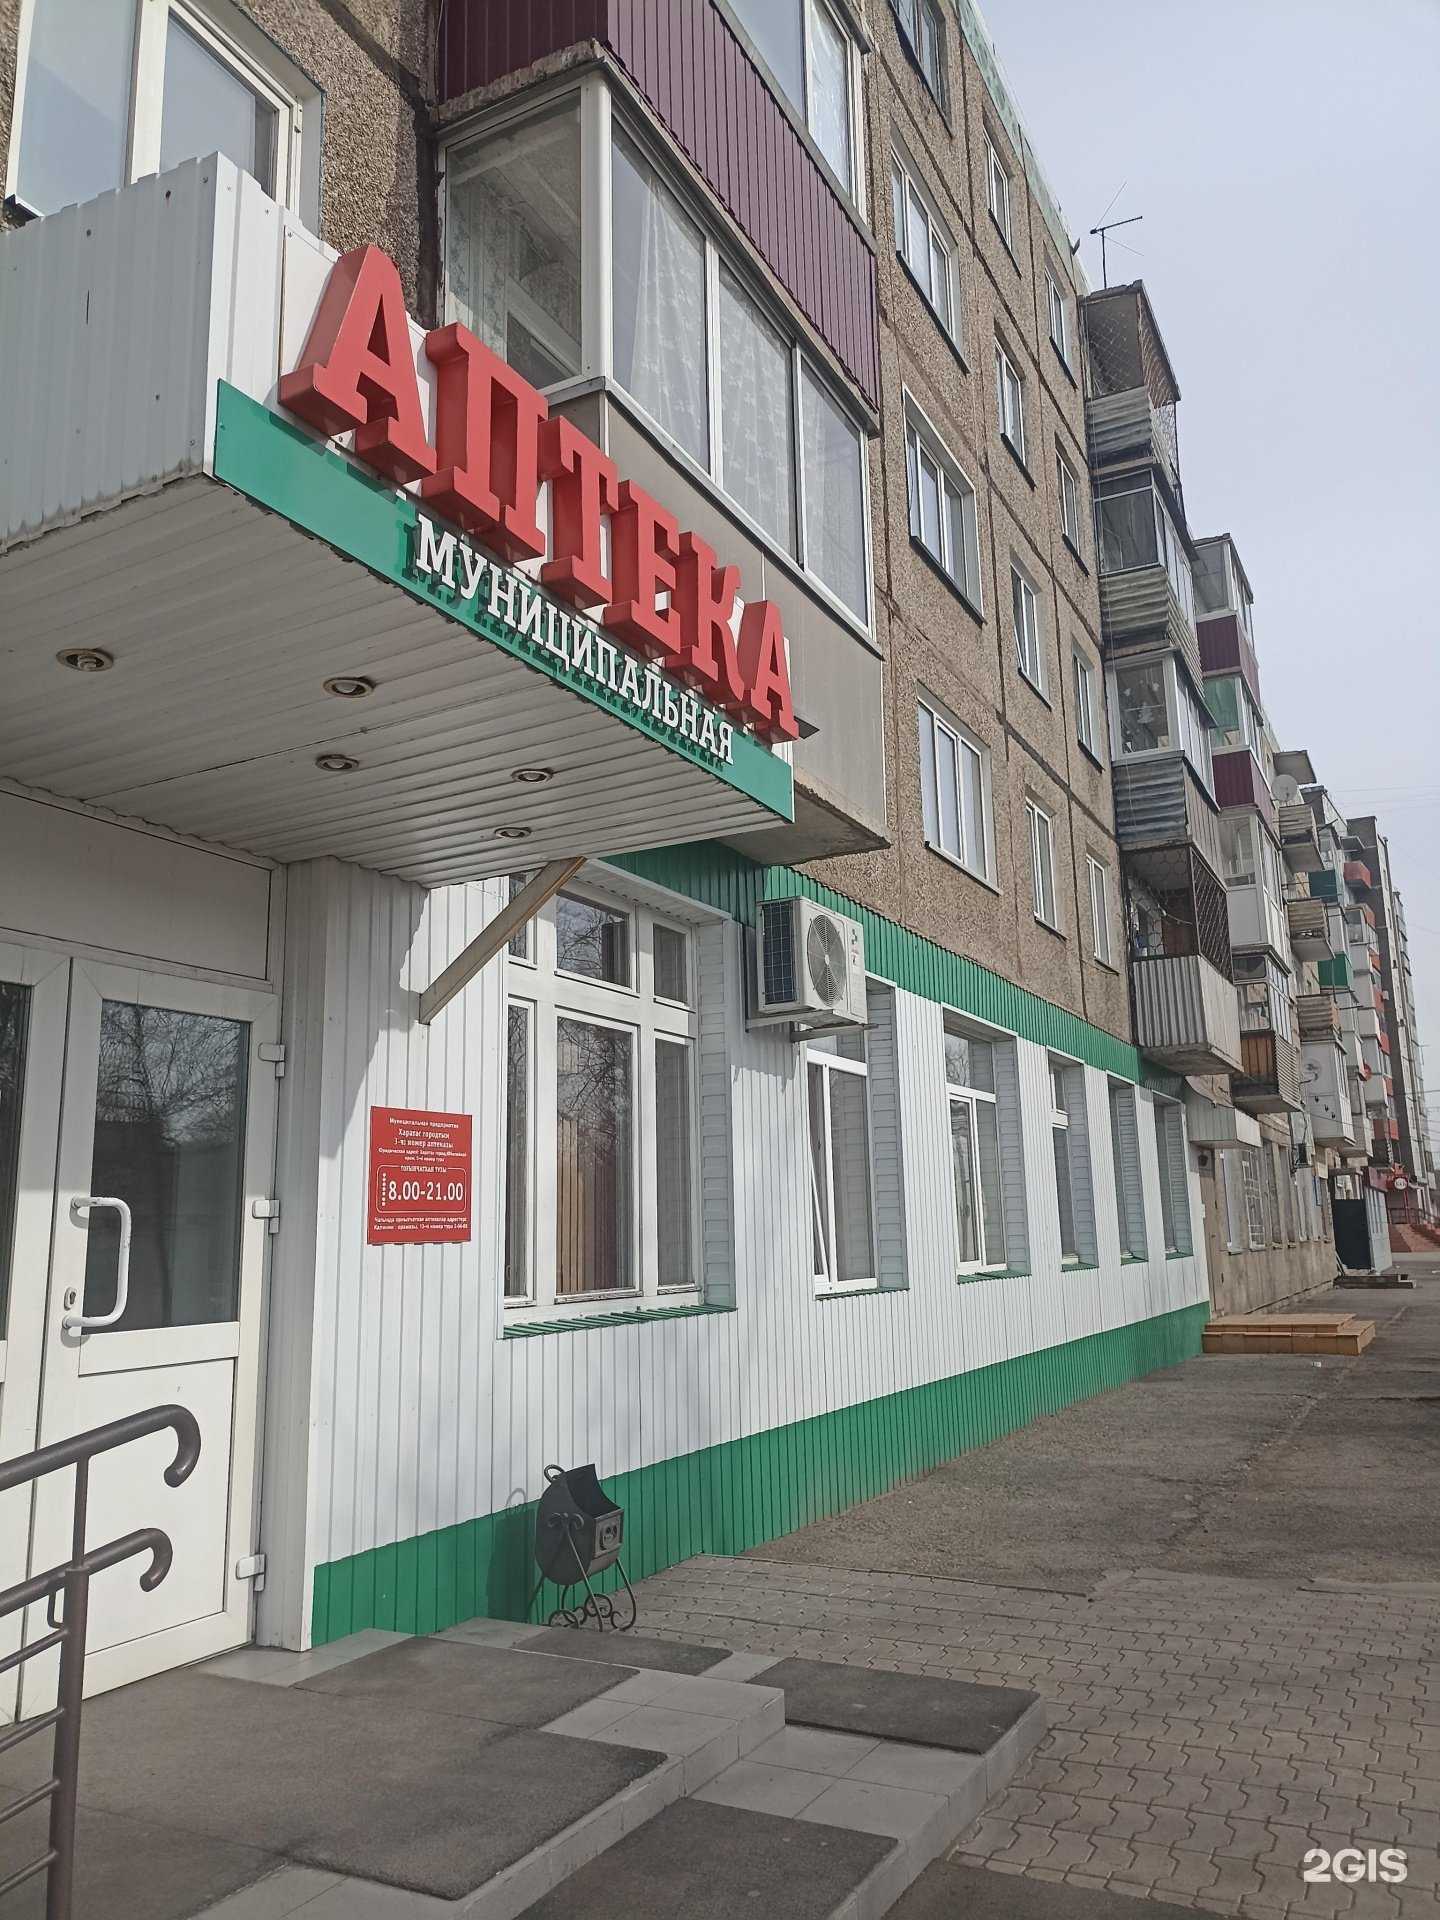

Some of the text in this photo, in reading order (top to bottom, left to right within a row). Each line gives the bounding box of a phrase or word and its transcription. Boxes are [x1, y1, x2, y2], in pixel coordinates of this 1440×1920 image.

[279, 244, 799, 743] АПТЕКА
[415, 513, 734, 765] МУНИЦИПАЛЬНАЯ
[388, 1181, 463, 1201] 8.00-21.00
